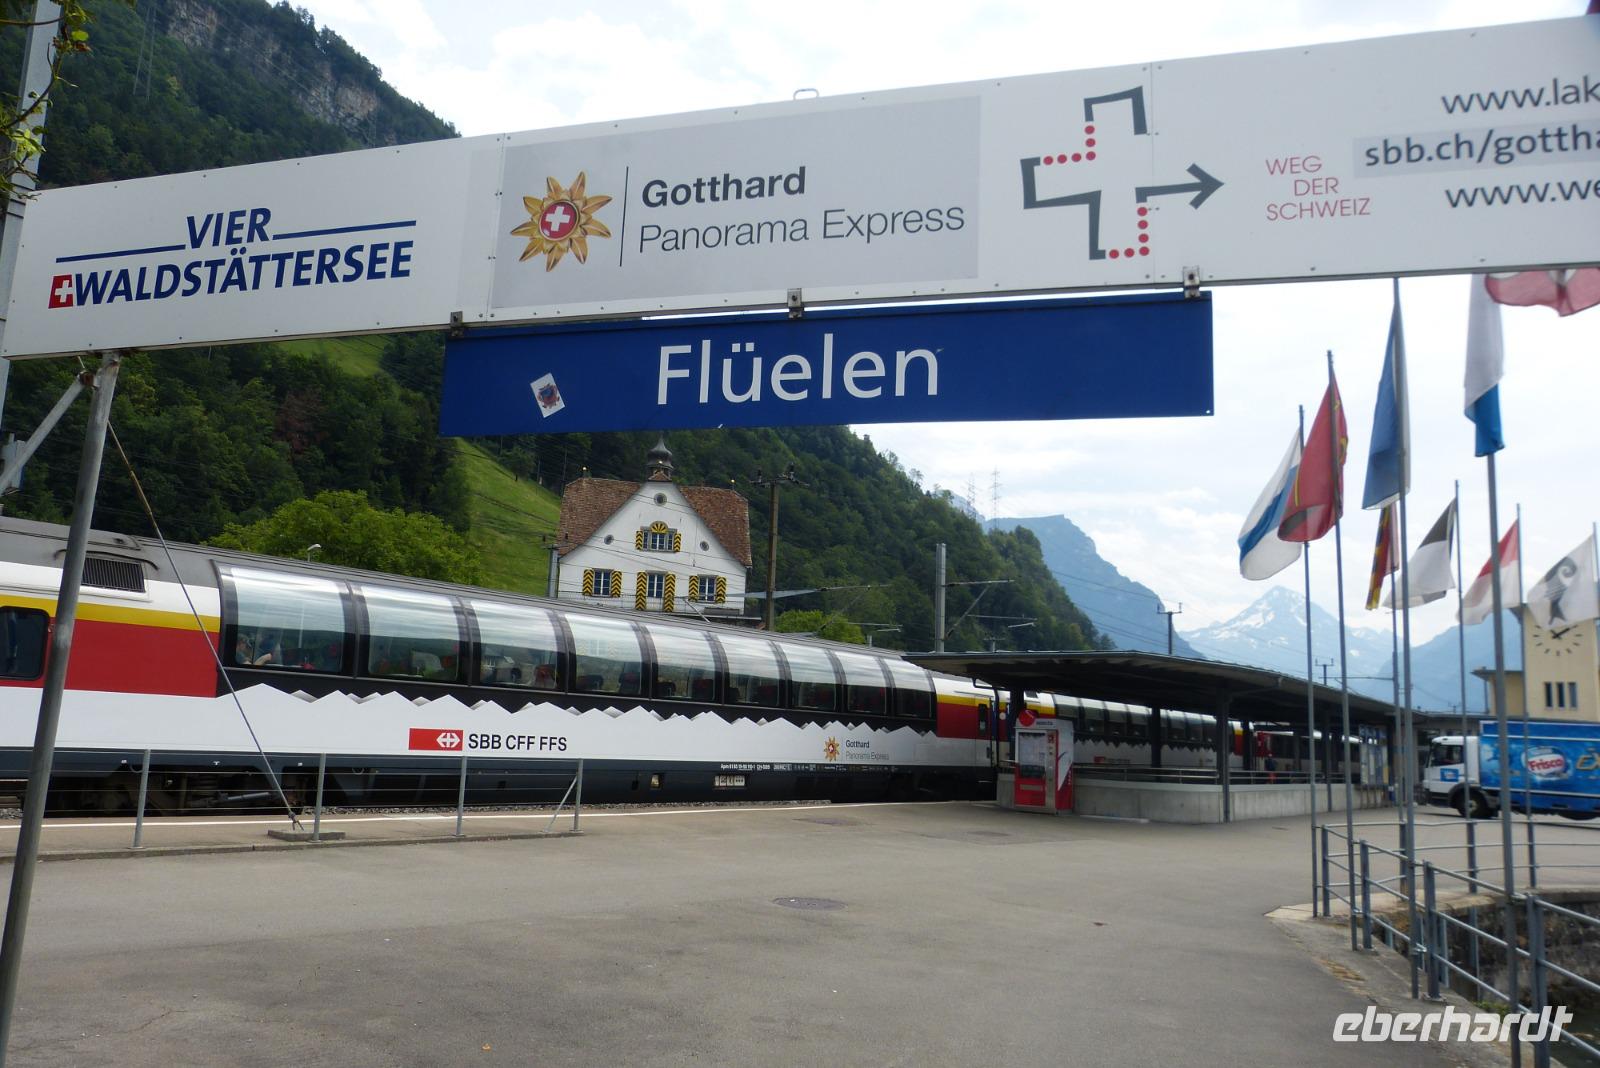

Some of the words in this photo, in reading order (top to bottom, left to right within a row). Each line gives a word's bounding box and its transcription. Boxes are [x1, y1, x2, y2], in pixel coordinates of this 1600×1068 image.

[1265, 155, 1322, 175] WEG
[642, 166, 806, 208] Gotthard
[1294, 177, 1339, 197] DER
[1266, 198, 1371, 221] SCHWEIZ
[186, 207, 271, 249] VIER
[639, 216, 809, 253] Panorama
[822, 206, 965, 244] Express
[73, 240, 414, 306] WALDSTÄTTERSEE
[657, 333, 939, 405] Flüelen
[468, 733, 502, 750] SBB
[505, 734, 535, 751] CFF
[539, 736, 567, 752] FFS
[845, 740, 870, 749] Gotthard
[1528, 758, 1565, 772] Frisco
